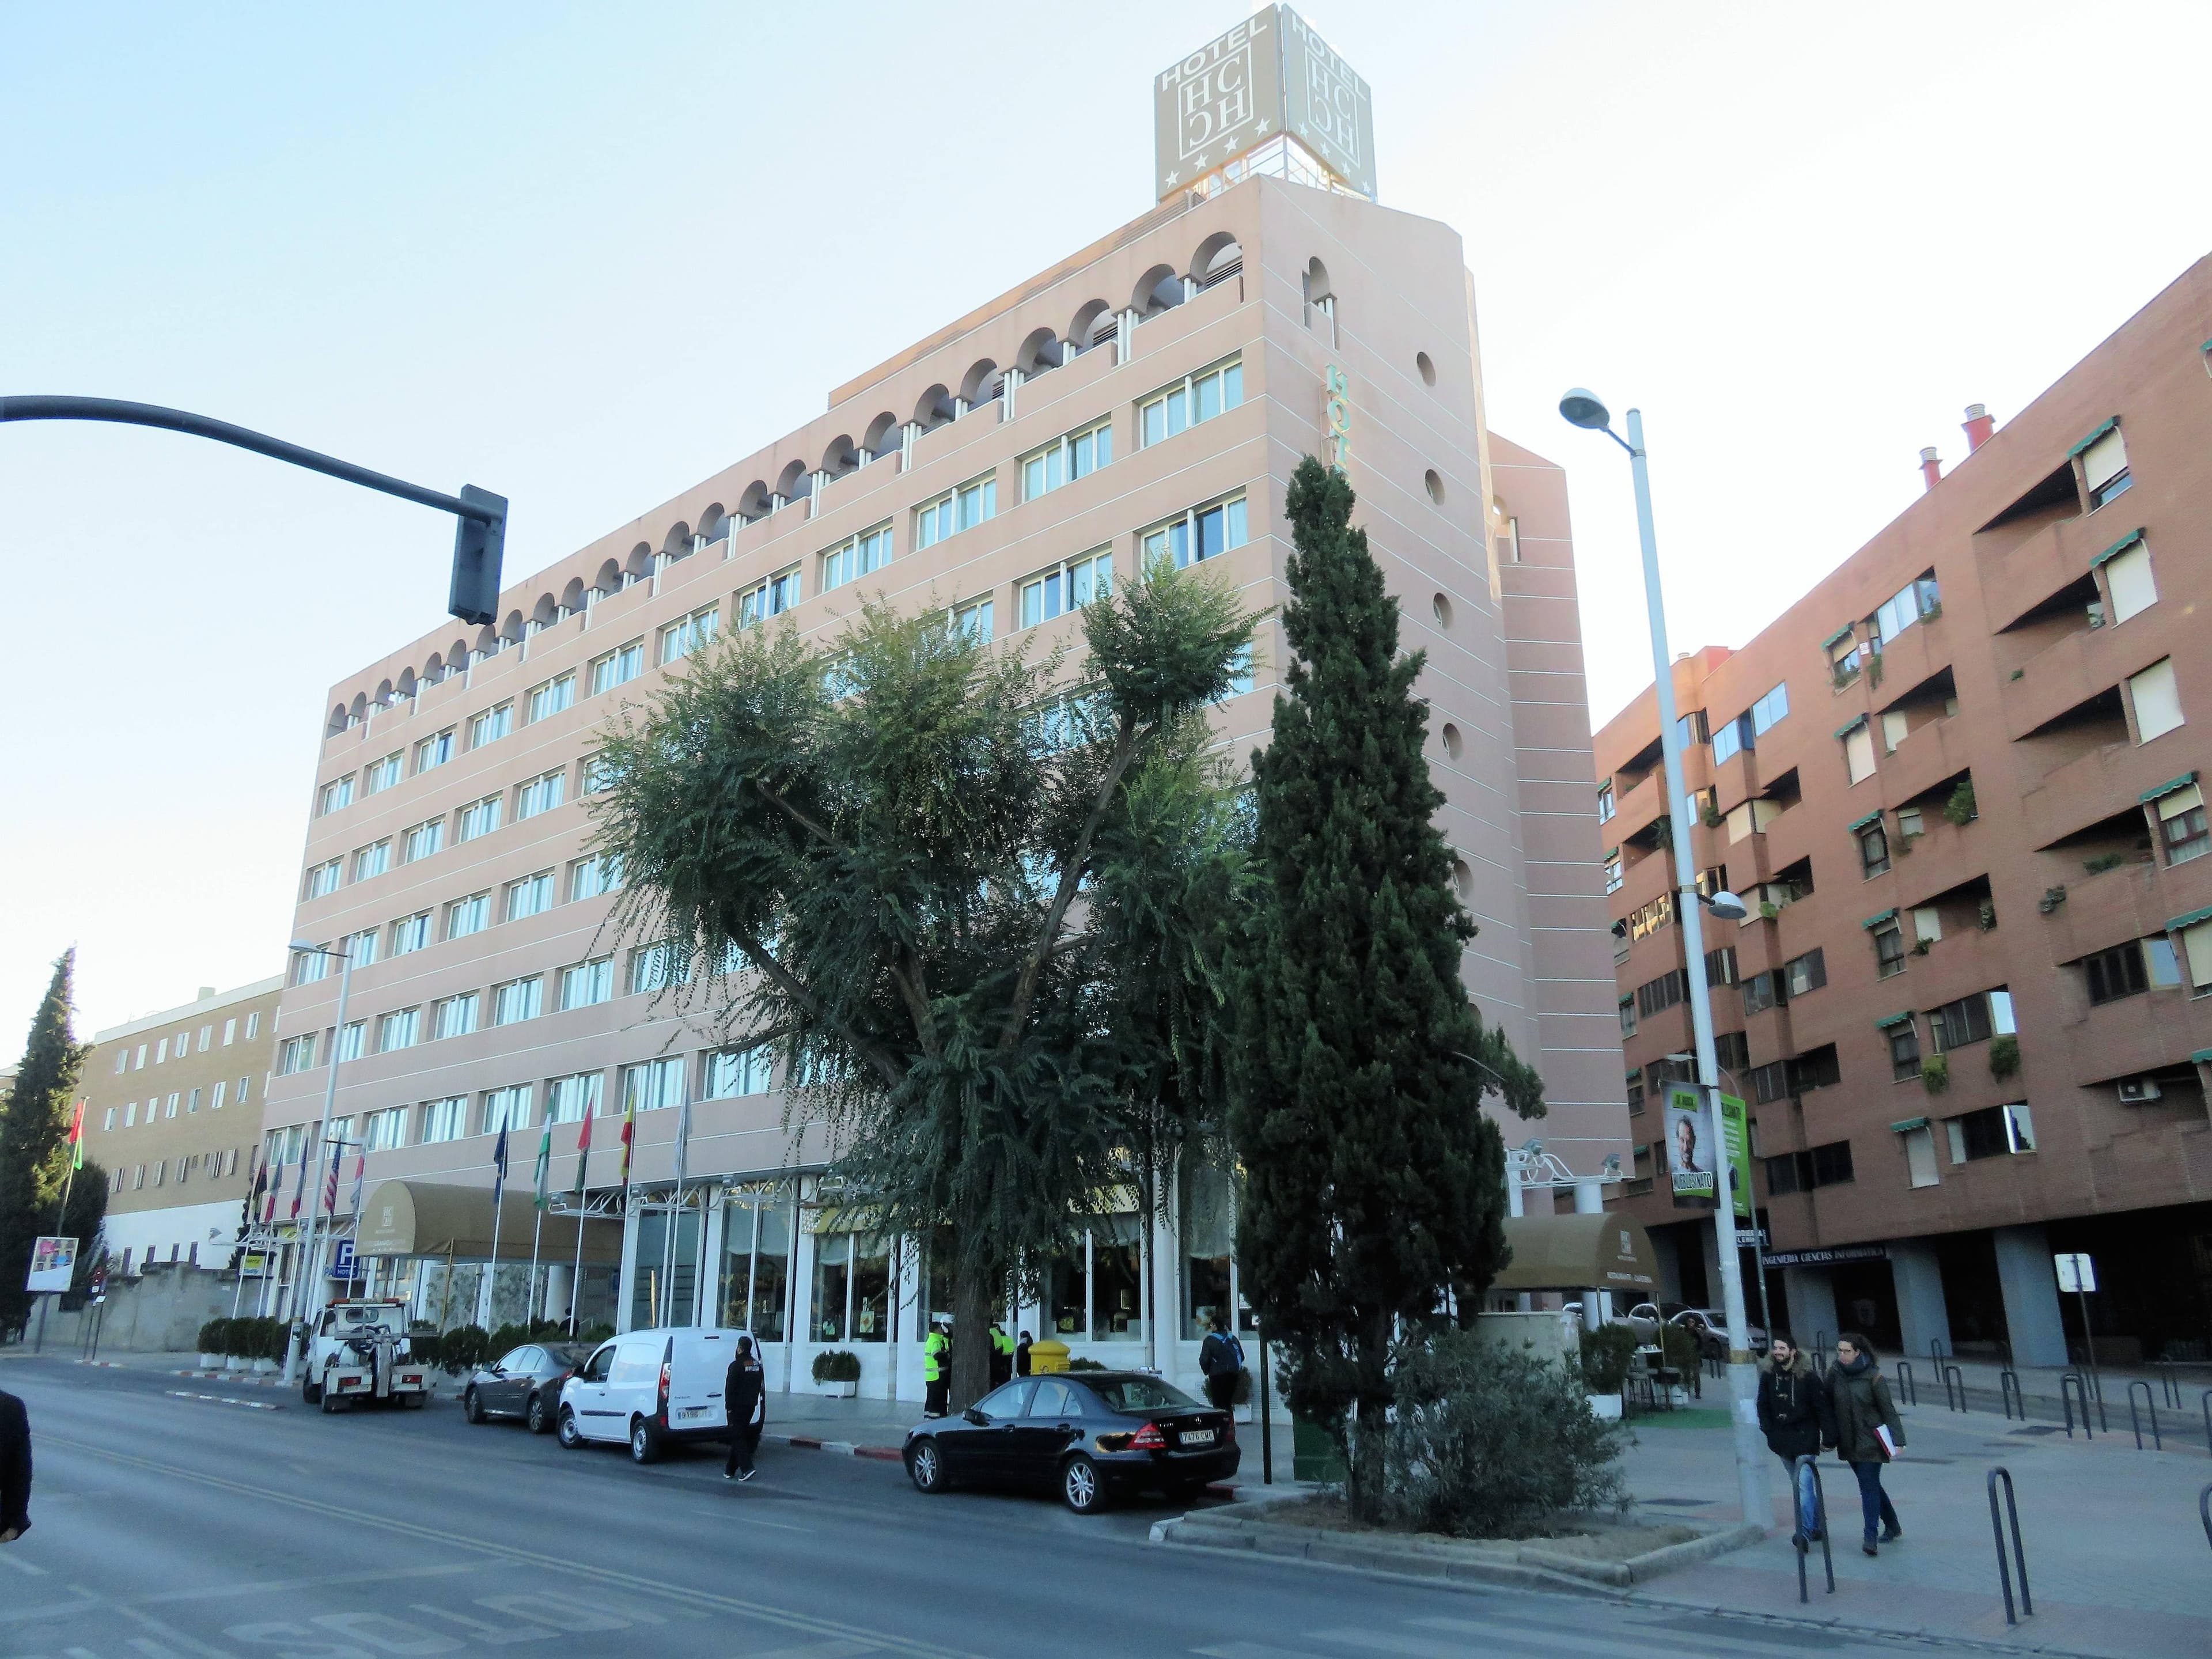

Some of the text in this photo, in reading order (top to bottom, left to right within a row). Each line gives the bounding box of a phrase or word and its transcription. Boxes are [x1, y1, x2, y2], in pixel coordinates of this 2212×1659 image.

[1162, 18, 1267, 92] HOTEL
[1184, 57, 1241, 116] HC
[1292, 13, 1366, 101] HOTEL
[1325, 363, 1351, 487] HOT
[340, 1243, 354, 1264] P
